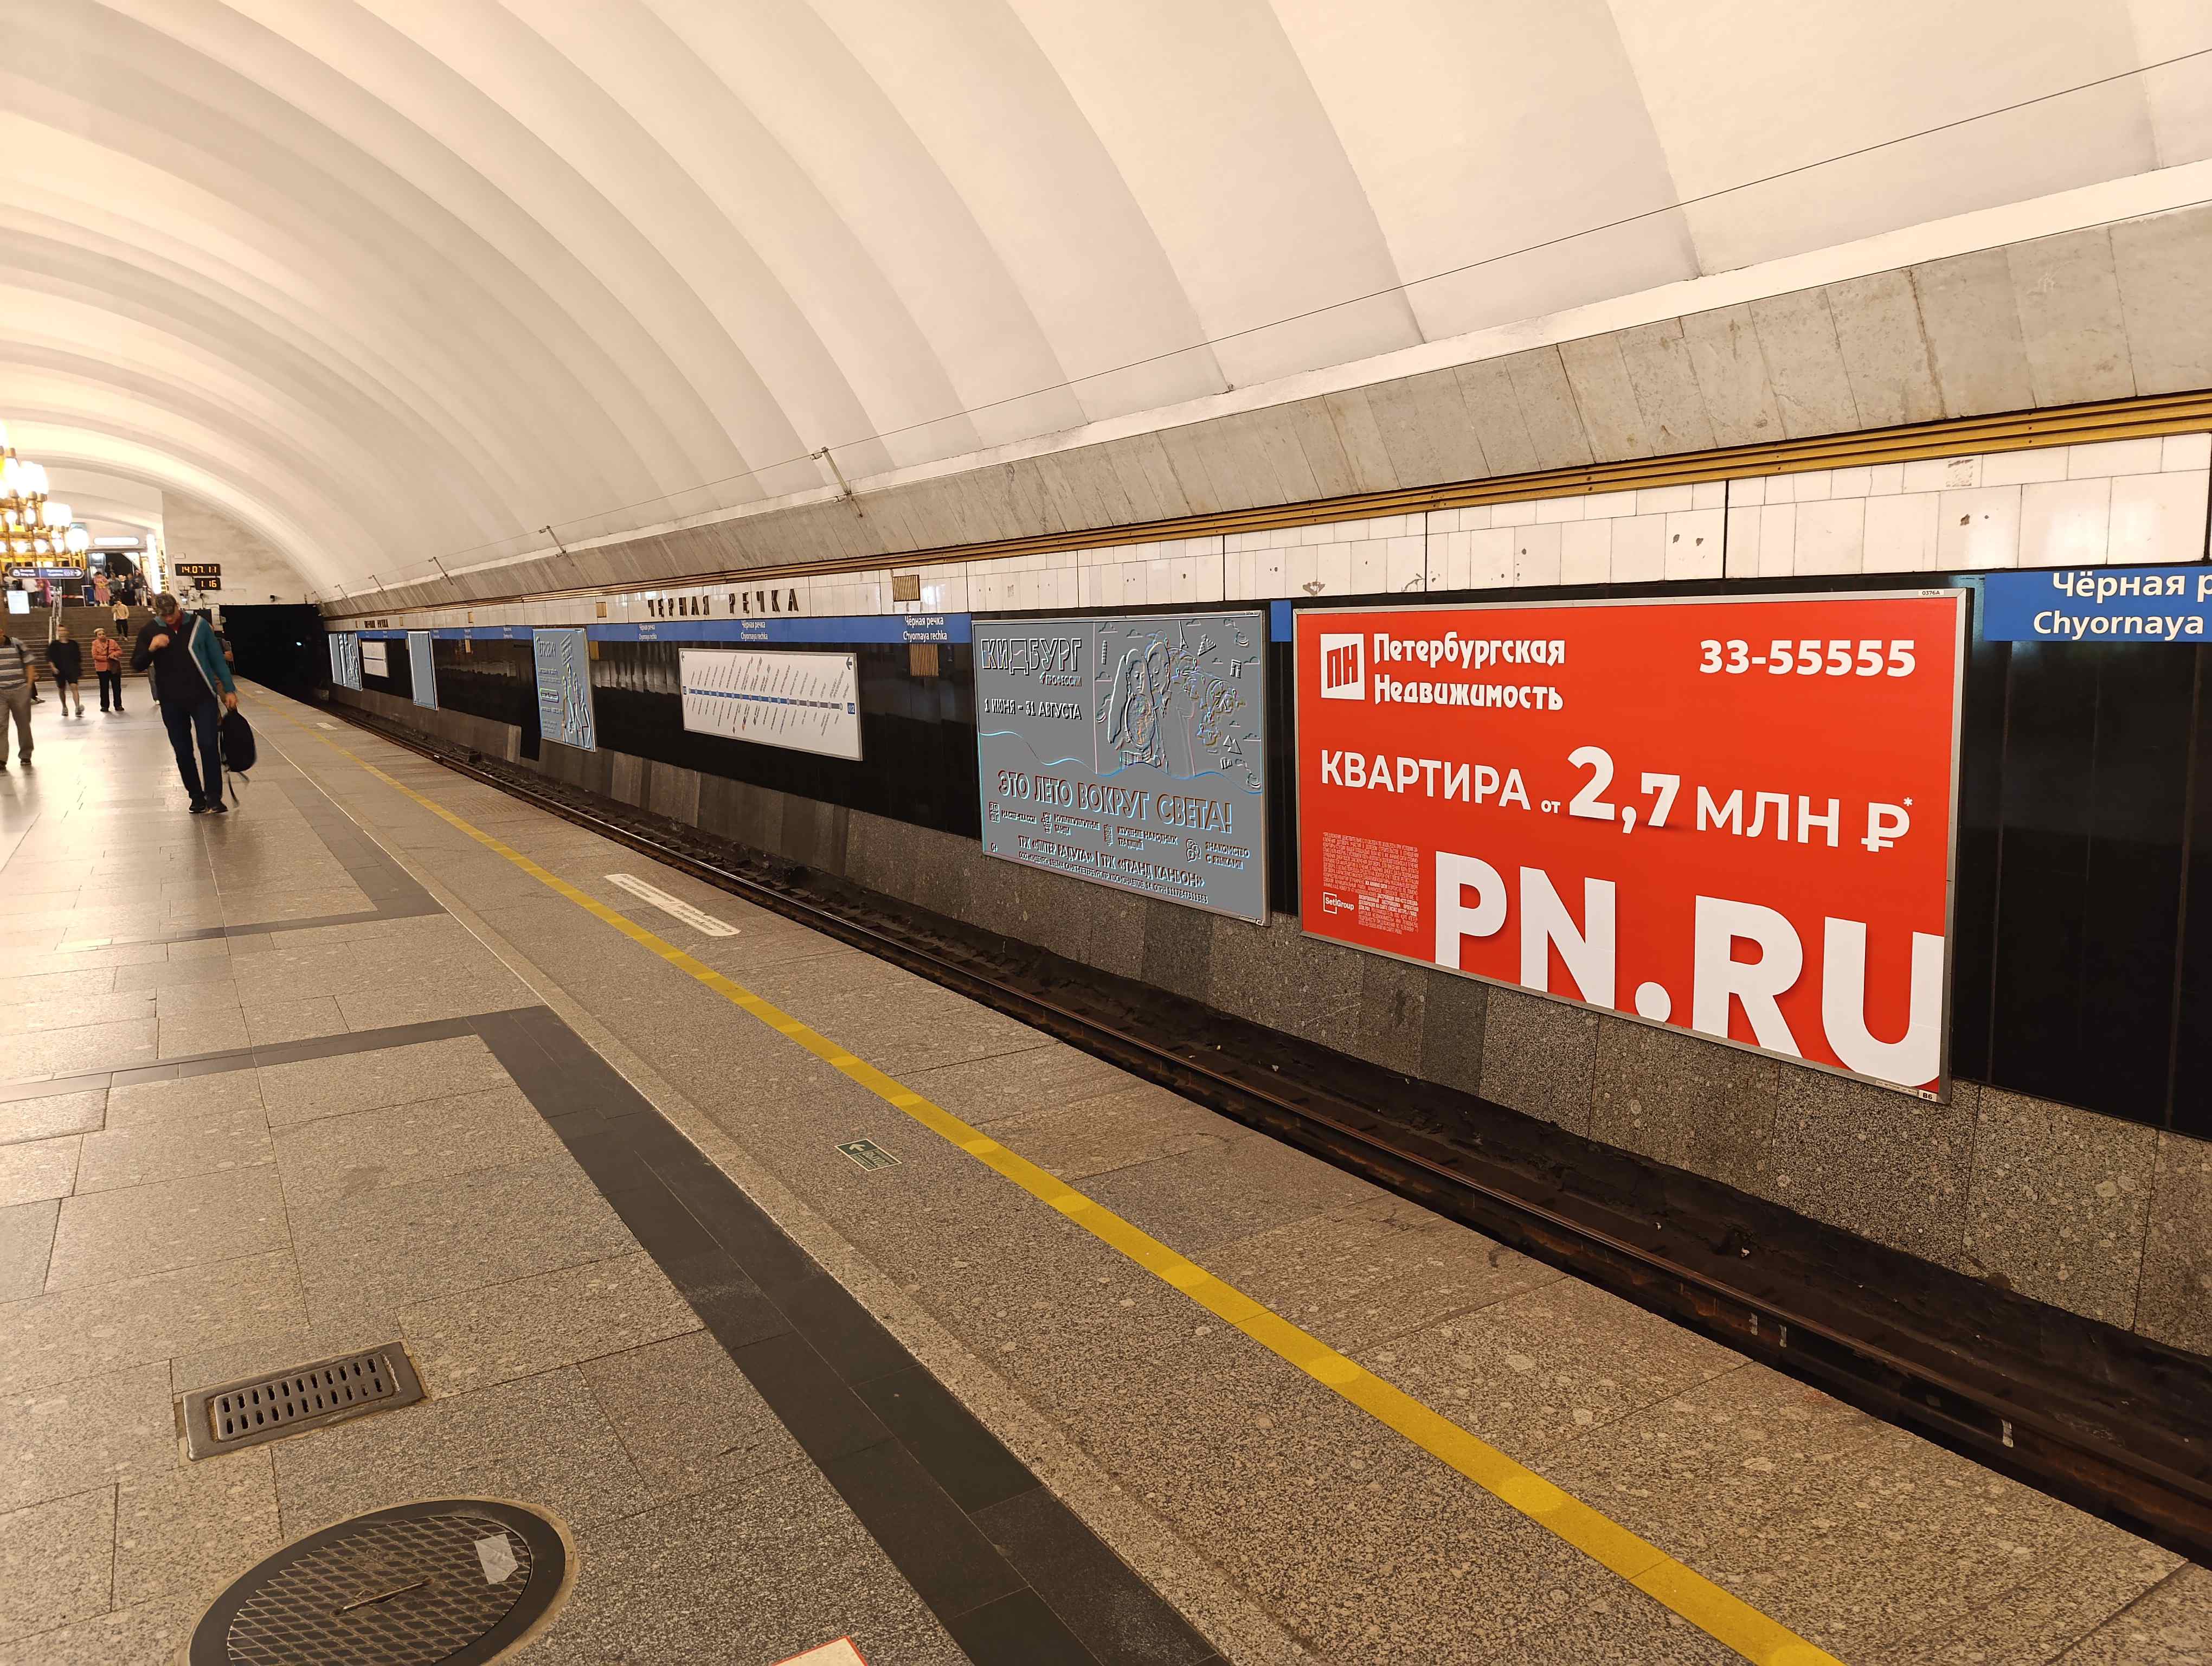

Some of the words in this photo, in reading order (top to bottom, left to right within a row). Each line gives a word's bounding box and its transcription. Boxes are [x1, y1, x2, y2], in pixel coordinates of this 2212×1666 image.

[647, 595, 710, 617] ЧЕРНАЯ
[729, 588, 799, 614] РЕЧКА
[2053, 571, 2186, 604] Чёрная
[903, 631, 929, 642] Chyornaya
[930, 630, 947, 640] rechka
[905, 616, 925, 629] Чёрная
[927, 617, 943, 628] речка
[2033, 610, 2204, 640] Chyornaya
[981, 638, 1082, 676] КИДБУРГ
[1374, 631, 1565, 669] Петербургская
[1699, 639, 1916, 677] 33-55555
[985, 698, 990, 713] 1
[992, 699, 1016, 715] ИЮНЯ
[1026, 701, 1036, 716] 31
[1038, 702, 1082, 720] АВГУСТА
[1374, 674, 1564, 711] Недвижимость
[998, 770, 1030, 799] ЭТО
[1034, 776, 1072, 807] ЛЕТО
[1078, 782, 1149, 820] ВОКРУГ
[1157, 793, 1232, 834] СВЕТА!
[1321, 749, 1532, 811] КВАРТИРА
[1541, 799, 1560, 814] от
[1567, 745, 1680, 835] 2,7
[1696, 785, 1840, 848] МЛН
[1019, 836, 1031, 850] ТРК
[1101, 854, 1116, 869] ТРК
[1205, 842, 1250, 858] ЗНАКОМСТВО
[1206, 854, 1212, 863] С
[1435, 851, 1945, 1087] PN.RU
[862, 1151, 890, 1167] ВЫХОД
